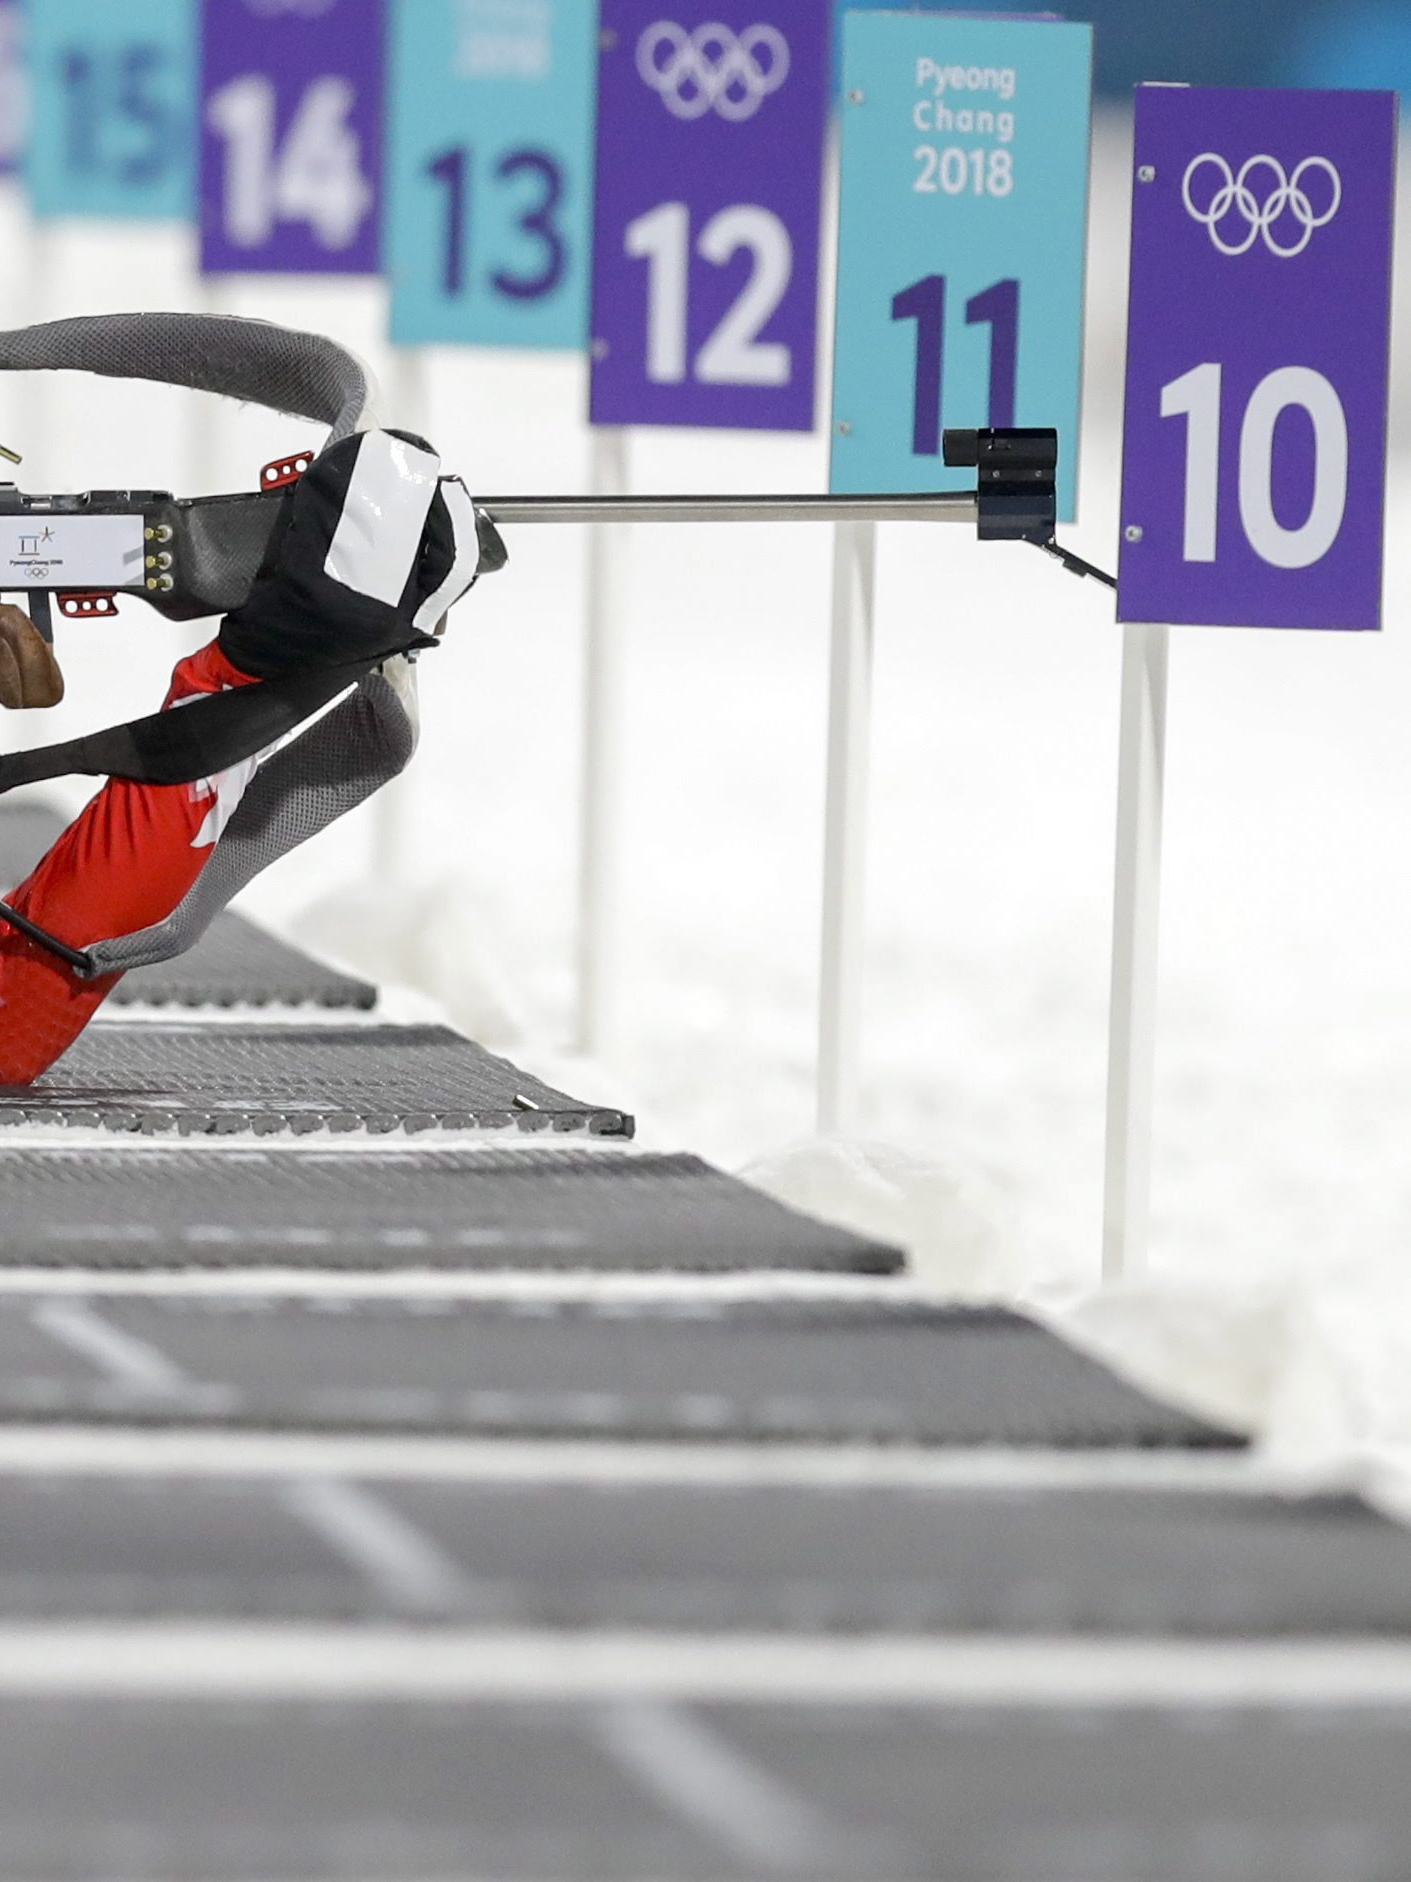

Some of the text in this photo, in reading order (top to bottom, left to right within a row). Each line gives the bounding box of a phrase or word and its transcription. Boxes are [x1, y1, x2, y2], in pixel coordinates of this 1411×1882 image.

[60, 42, 168, 188] 15
[913, 100, 1015, 143] Chang
[916, 57, 1016, 99] Pyeong
[208, 74, 372, 251] 14
[423, 144, 567, 303] 13
[913, 144, 1014, 196] 2018
[624, 201, 793, 388] 12
[892, 273, 1020, 456] 11
[1160, 362, 1349, 569] 10
